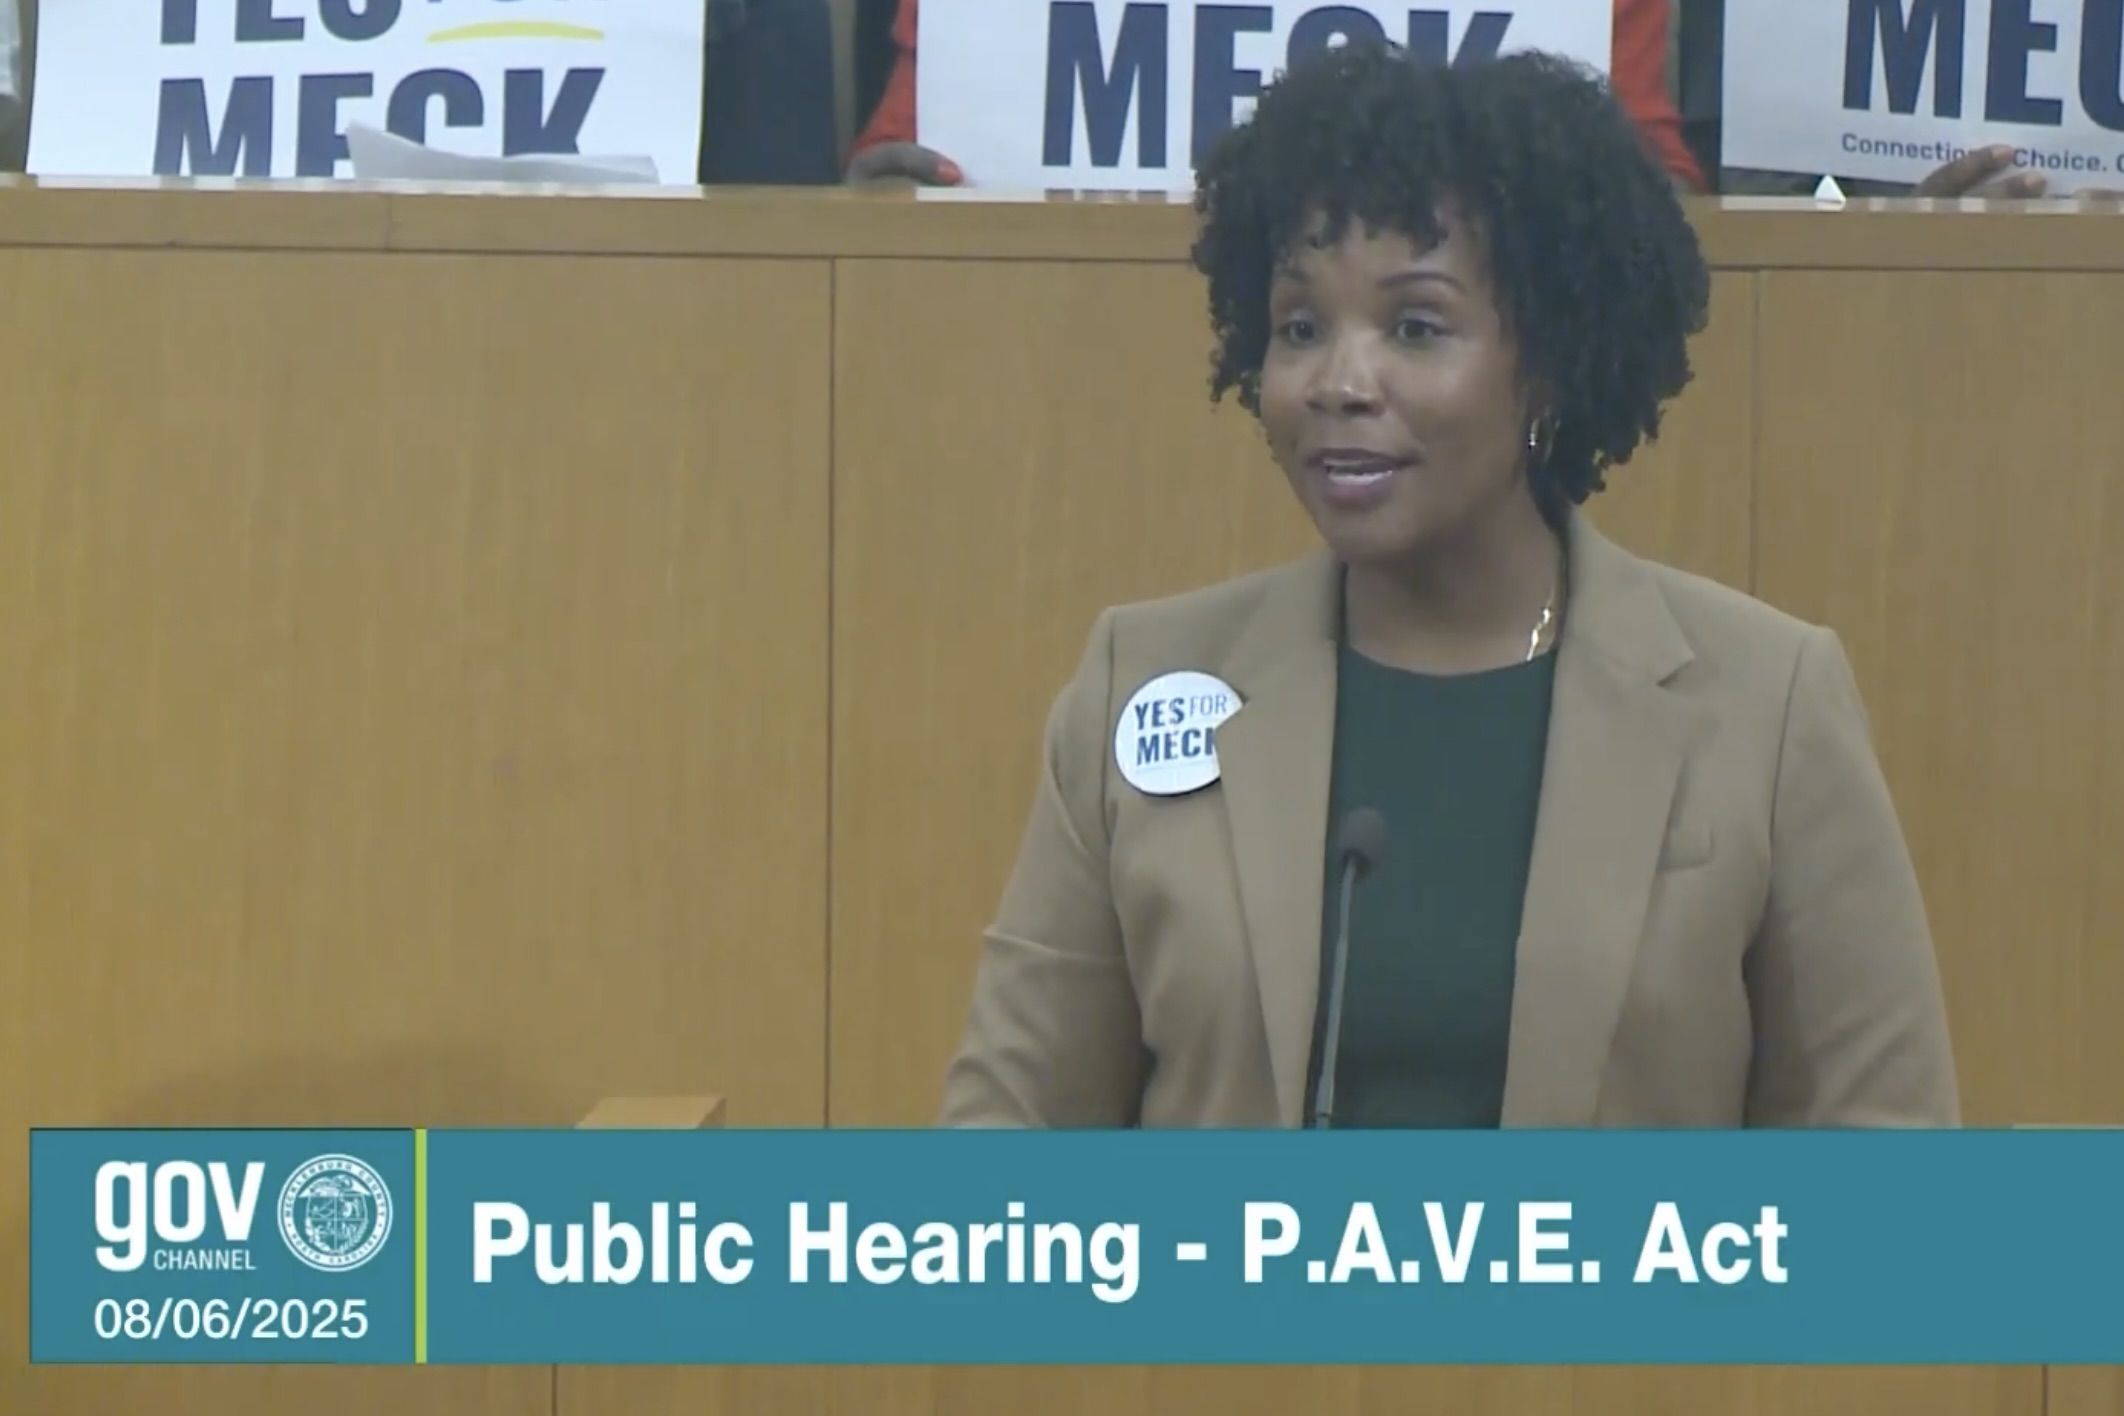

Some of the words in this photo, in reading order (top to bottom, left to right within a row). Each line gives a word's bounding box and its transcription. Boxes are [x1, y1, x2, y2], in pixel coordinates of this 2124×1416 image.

[1841, 133, 1976, 164] Connectio
[2013, 147, 2107, 172] Choice.
[1134, 697, 1185, 730] YES
[1189, 693, 1227, 717] FOR
